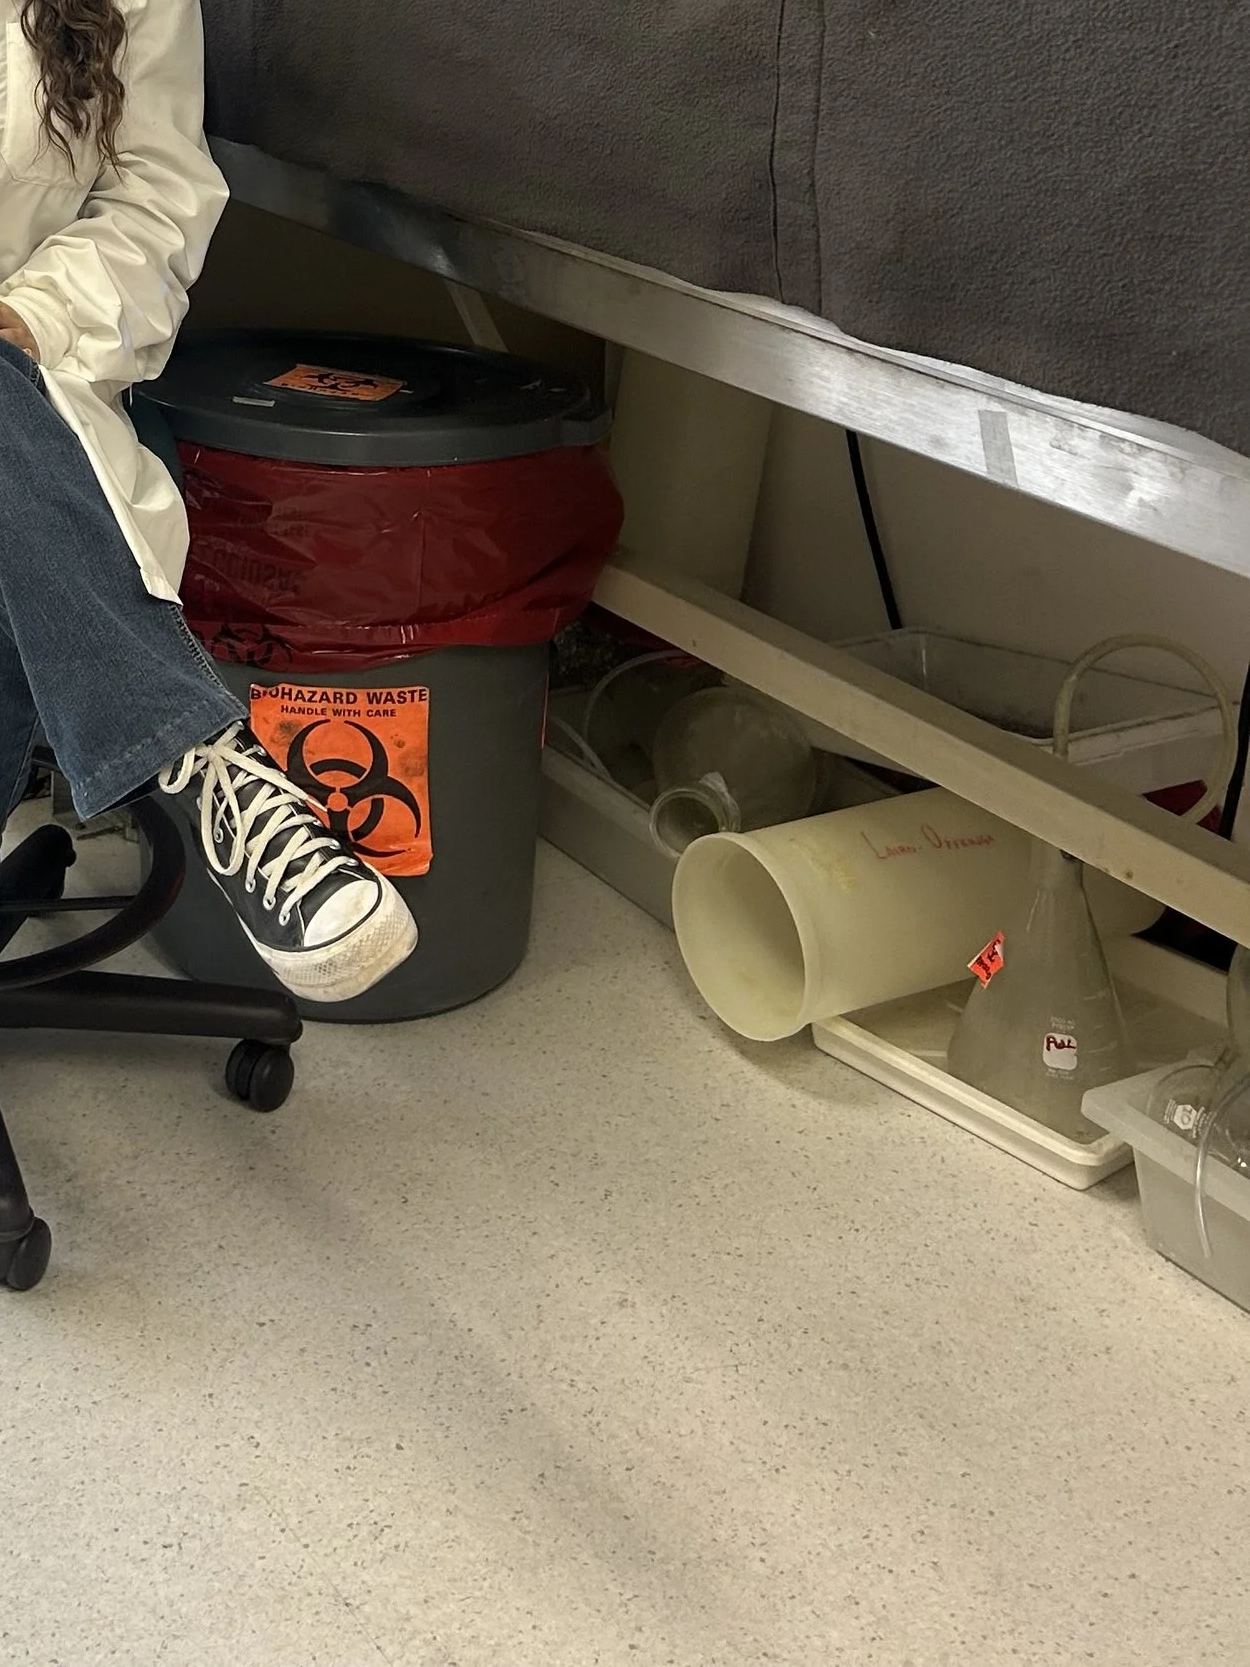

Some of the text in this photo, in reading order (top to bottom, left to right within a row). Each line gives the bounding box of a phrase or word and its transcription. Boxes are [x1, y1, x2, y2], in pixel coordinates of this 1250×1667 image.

[366, 688, 428, 705] WASTE
[280, 705, 397, 718] HANDLE WITH CARE
